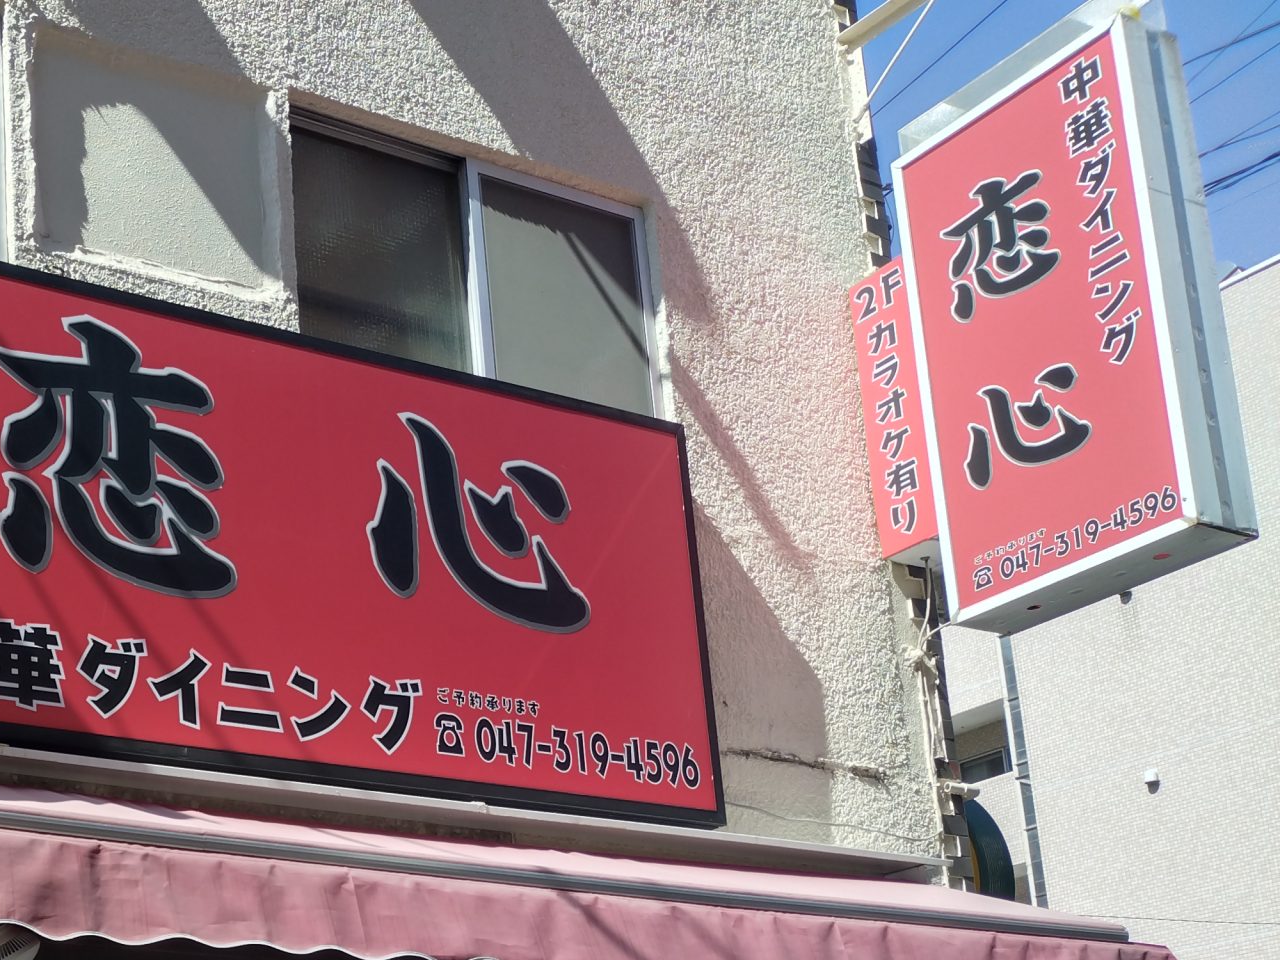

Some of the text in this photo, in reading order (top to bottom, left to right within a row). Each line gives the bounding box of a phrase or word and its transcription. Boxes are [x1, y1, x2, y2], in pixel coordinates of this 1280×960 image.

[1058, 54, 1144, 365] 中華ダイニング
[940, 169, 1092, 491] 恋心
[998, 486, 1177, 580] 047-319-4596
[437, 687, 540, 718] ご予約承ります
[474, 717, 701, 790] 047-319-4596
